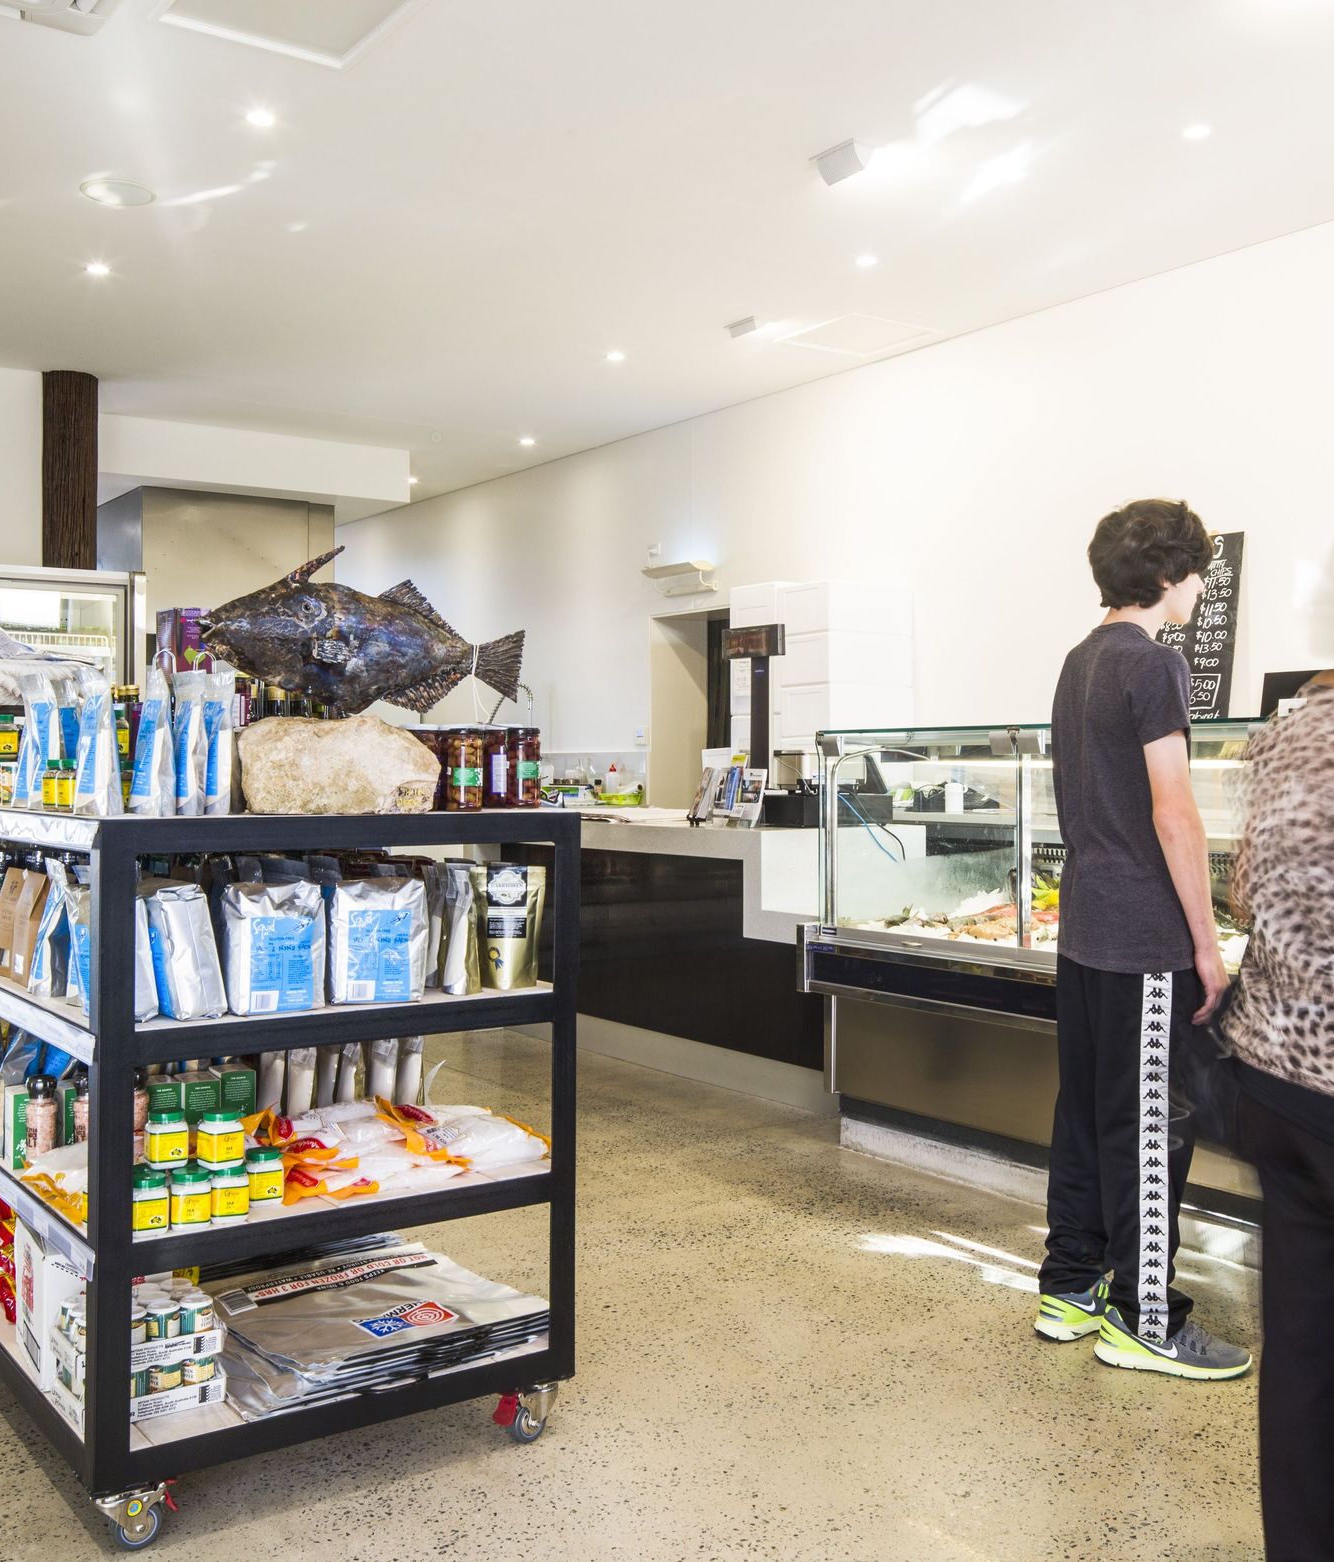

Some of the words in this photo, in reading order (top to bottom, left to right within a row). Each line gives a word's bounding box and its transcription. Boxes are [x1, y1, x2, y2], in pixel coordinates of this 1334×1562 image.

[366, 1260, 391, 1270] COLD
[393, 1257, 406, 1266] OR
[350, 1266, 365, 1276] OR
[310, 1271, 349, 1286] FROZEN
[281, 1284, 289, 1292] 3
[290, 1279, 309, 1291] FOR
